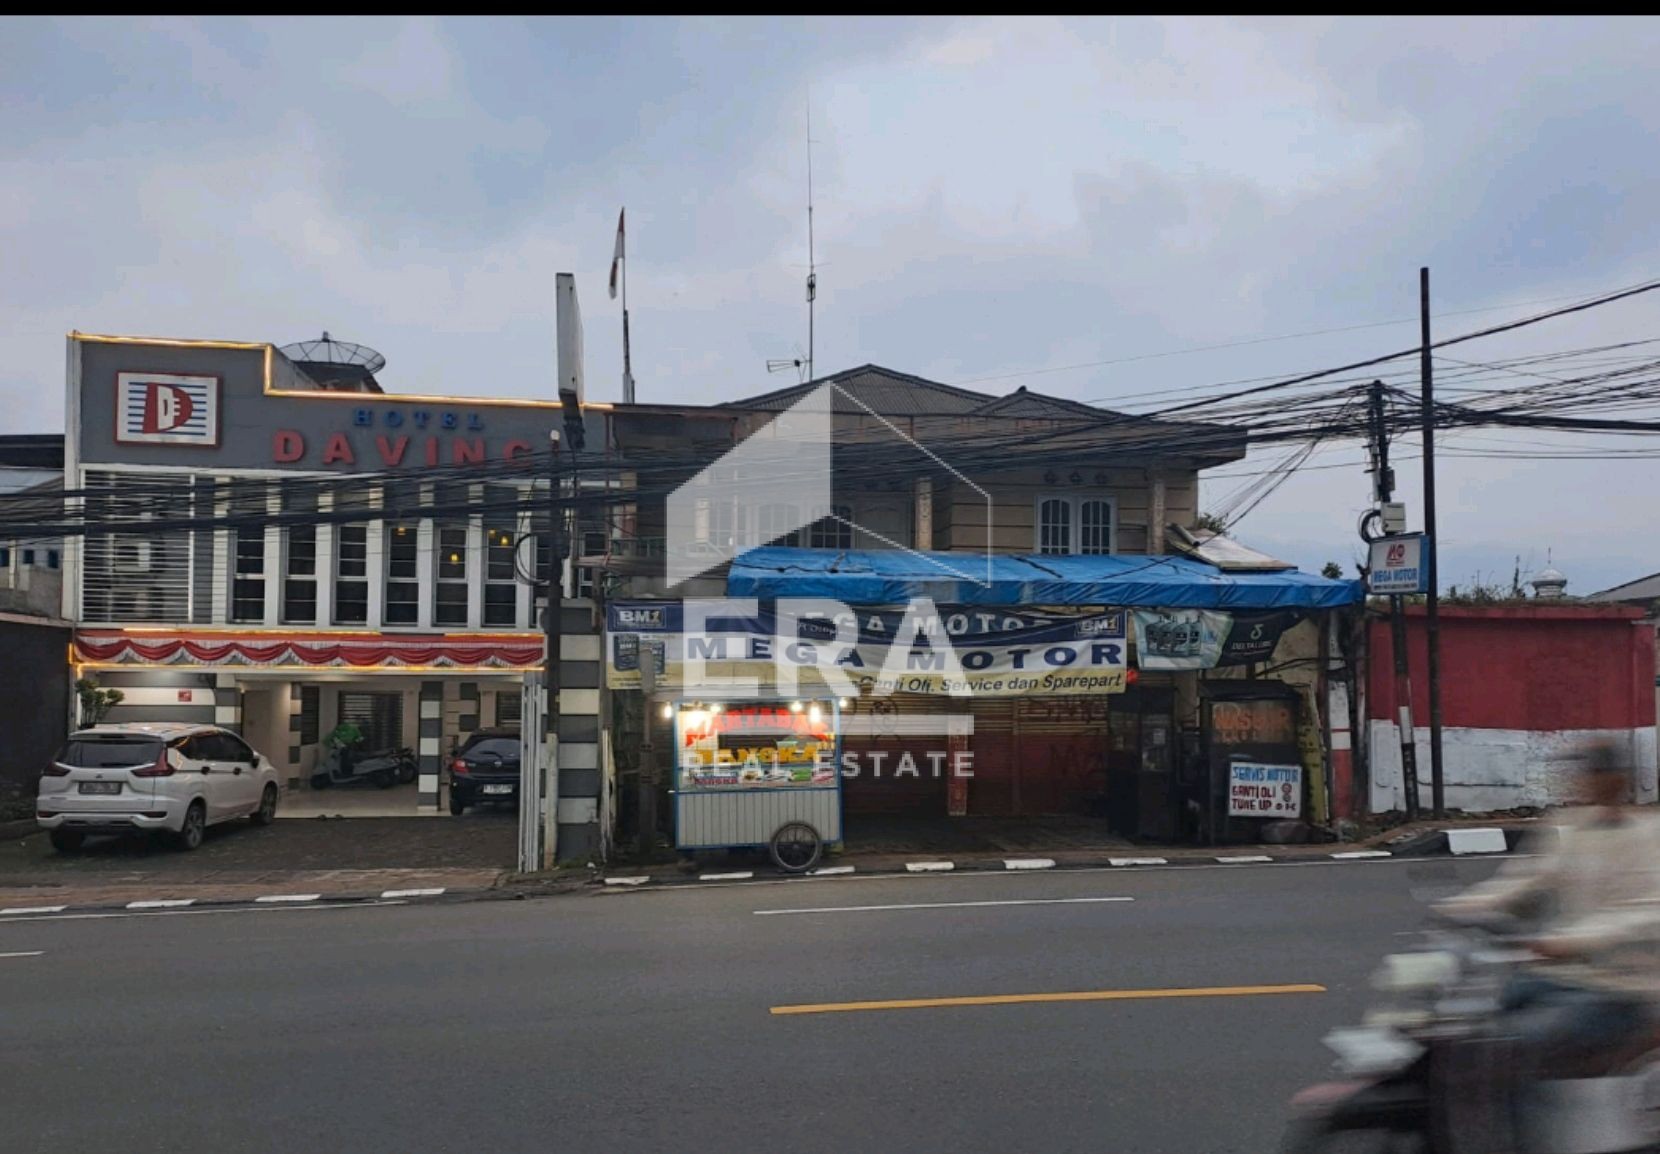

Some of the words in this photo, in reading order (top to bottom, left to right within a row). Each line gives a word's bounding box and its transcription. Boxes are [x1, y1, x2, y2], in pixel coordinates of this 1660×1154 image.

[353, 408, 485, 431] HOTEL
[911, 612, 1053, 636] MOTO
[687, 637, 864, 668] MEGA
[906, 643, 1122, 671] MOTOR
[940, 677, 1004, 692] Service
[1008, 677, 1039, 690] dan
[1042, 672, 1121, 691] Sparepart
[1267, 767, 1299, 782] MOTOR
[1231, 798, 1257, 811] TUNE
[1258, 799, 1273, 812] UP
